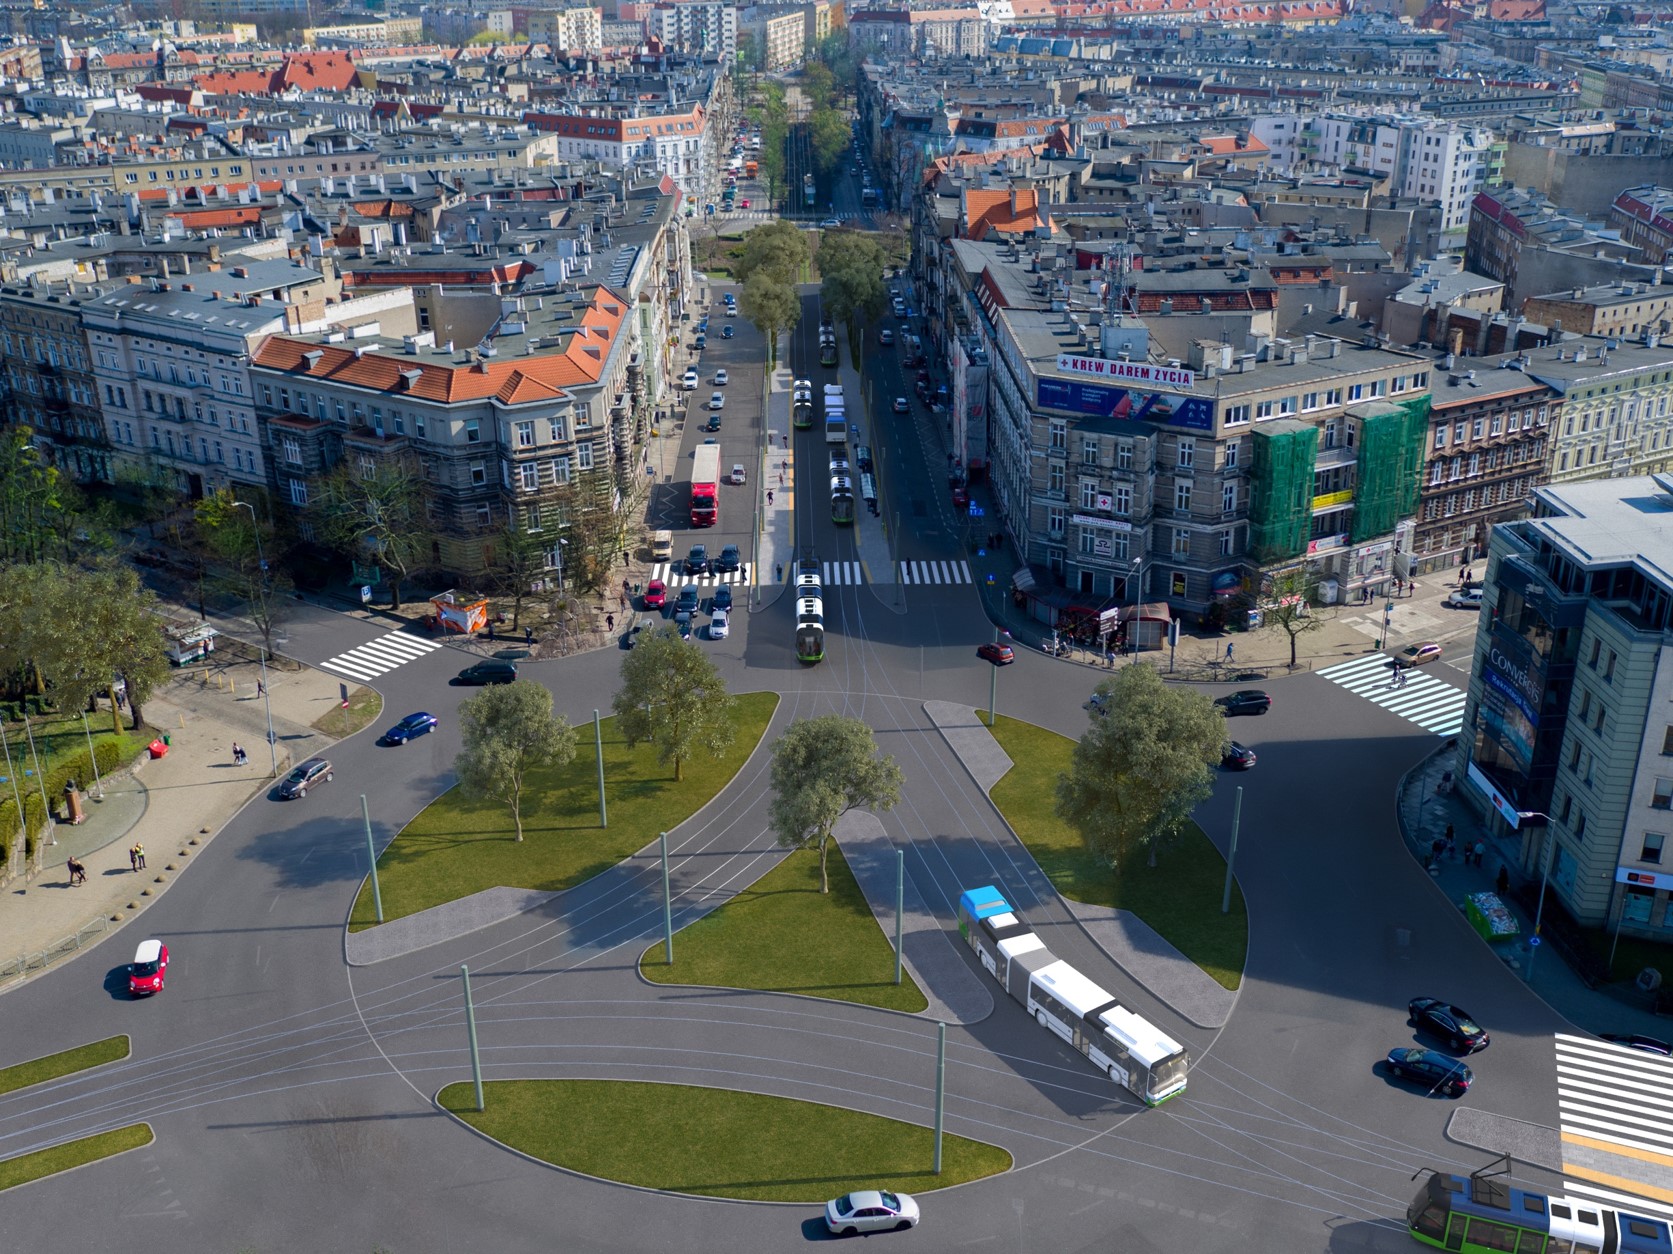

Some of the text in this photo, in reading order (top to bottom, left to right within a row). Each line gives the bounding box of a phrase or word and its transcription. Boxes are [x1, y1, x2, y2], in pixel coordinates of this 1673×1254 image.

[1072, 359, 1104, 373] KREW
[1110, 363, 1150, 379] DAREM
[1491, 648, 1539, 703] CONVERGYS
[1492, 674, 1522, 705] Rekrutacja
